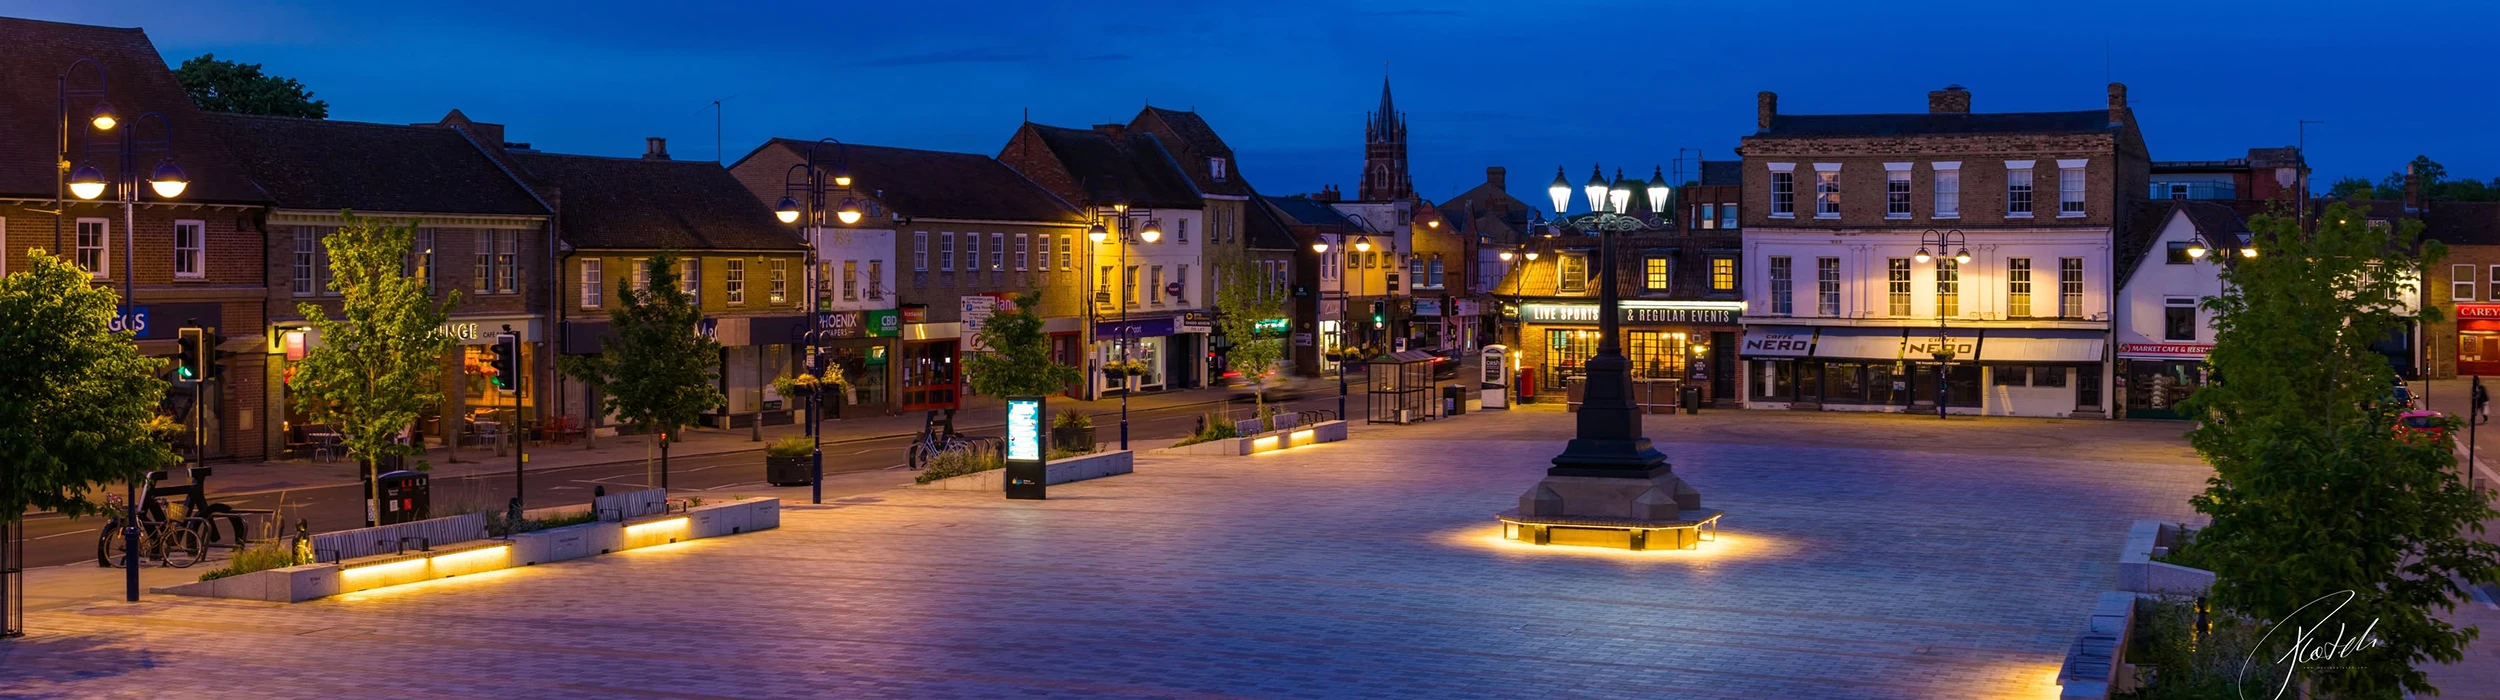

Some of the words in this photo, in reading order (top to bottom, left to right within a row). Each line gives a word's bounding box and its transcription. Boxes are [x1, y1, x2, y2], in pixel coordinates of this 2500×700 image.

[1534, 308, 1556, 320] LIVE
[1560, 308, 1599, 320] SPORTS
[1627, 309, 1634, 321] &
[1639, 309, 1686, 322] REGULAR
[1691, 310, 1729, 323] EVENTS
[881, 316, 897, 326] CBD
[1747, 340, 1807, 350] NERO
[1909, 343, 1972, 353] NERO
